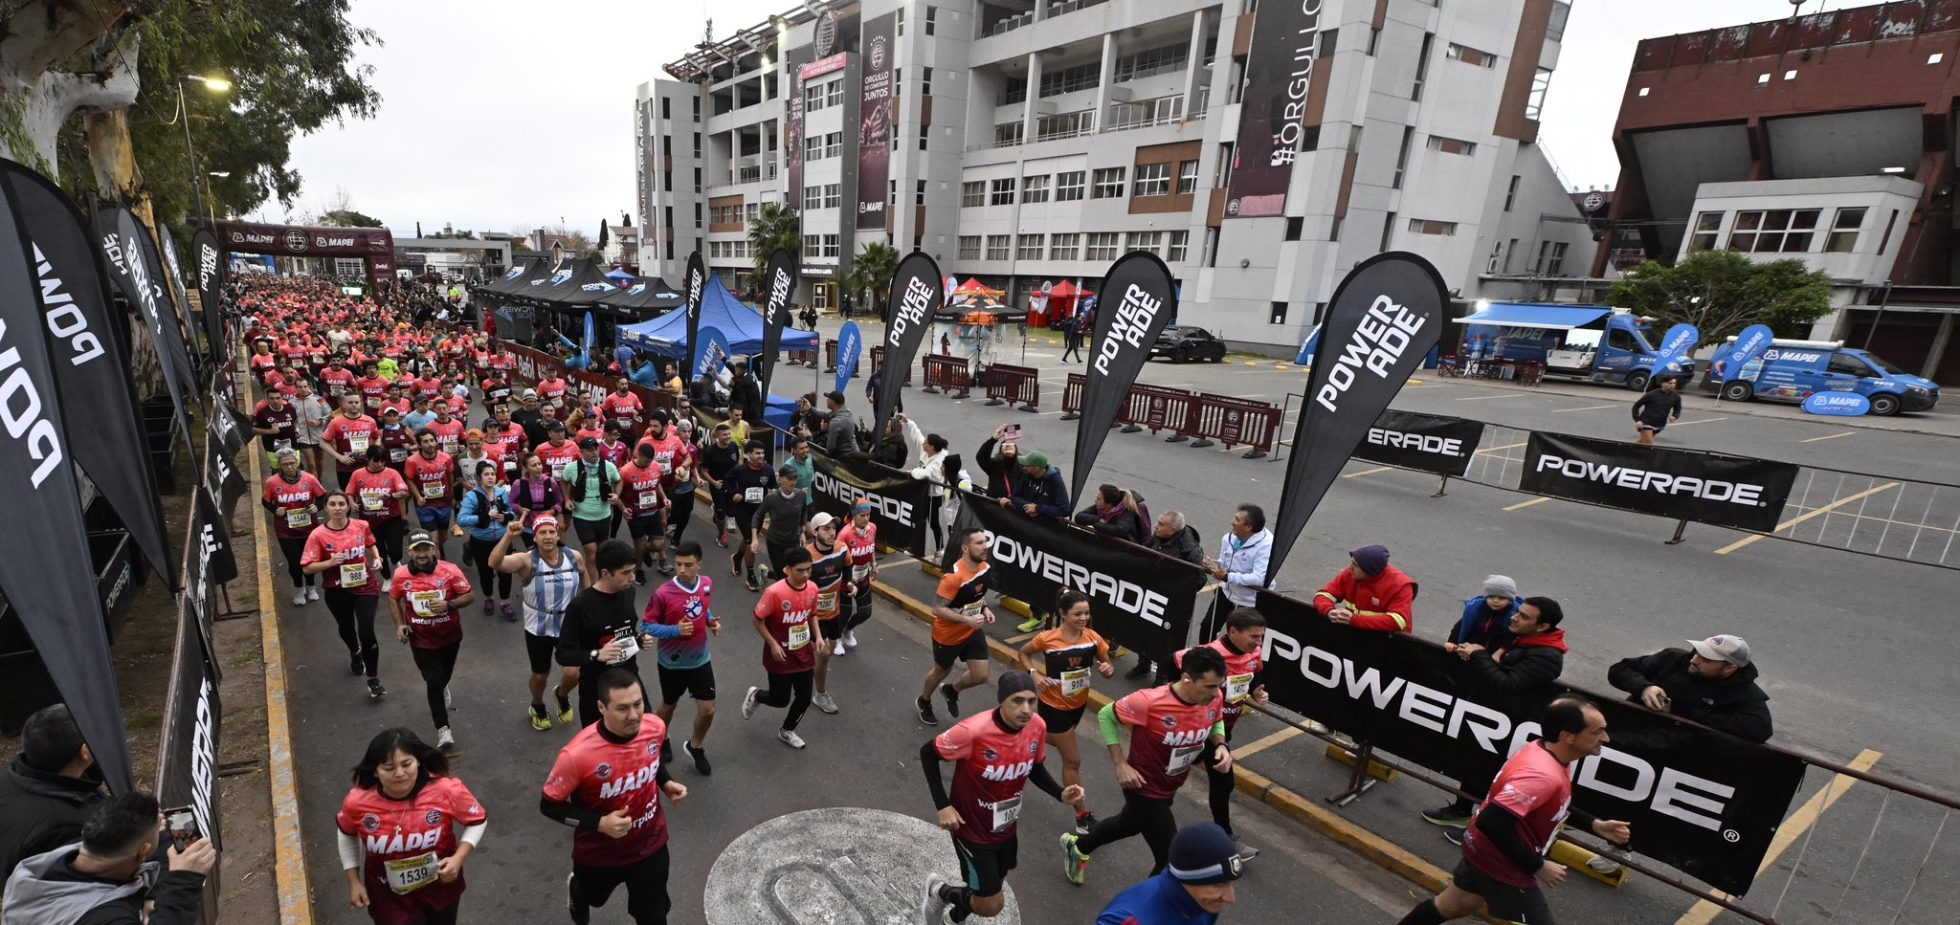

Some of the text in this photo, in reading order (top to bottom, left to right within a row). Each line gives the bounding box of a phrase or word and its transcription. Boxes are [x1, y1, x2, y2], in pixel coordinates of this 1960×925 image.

[864, 71, 888, 84] ORGULLO
[864, 88, 888, 101] JUNTOS
[246, 234, 275, 244] MAPEI
[329, 237, 355, 247] MAPEI
[202, 243, 213, 293] POWER
[208, 249, 219, 276] ADE
[689, 267, 699, 318] POWER
[694, 275, 702, 302] ADE
[767, 266, 786, 325] POWER
[778, 274, 792, 306] ADE
[889, 275, 924, 348] POWER
[910, 282, 933, 326] ADE
[1094, 283, 1145, 377] POWER
[1125, 291, 1161, 349] ADE
[842, 333, 855, 364] MAPEI
[1316, 293, 1402, 413] POWER
[1366, 306, 1425, 379] ADE
[1742, 331, 1765, 354] MAPEI
[1780, 352, 1820, 363] MAPEI
[1828, 395, 1861, 407] MAPEI
[1368, 427, 1463, 458] ERADE
[1537, 453, 1764, 506] POWERADE
[278, 491, 310, 503] MAPEI
[350, 572, 362, 581] 988
[366, 827, 442, 855] MAPEI
[399, 866, 429, 885] 1539
